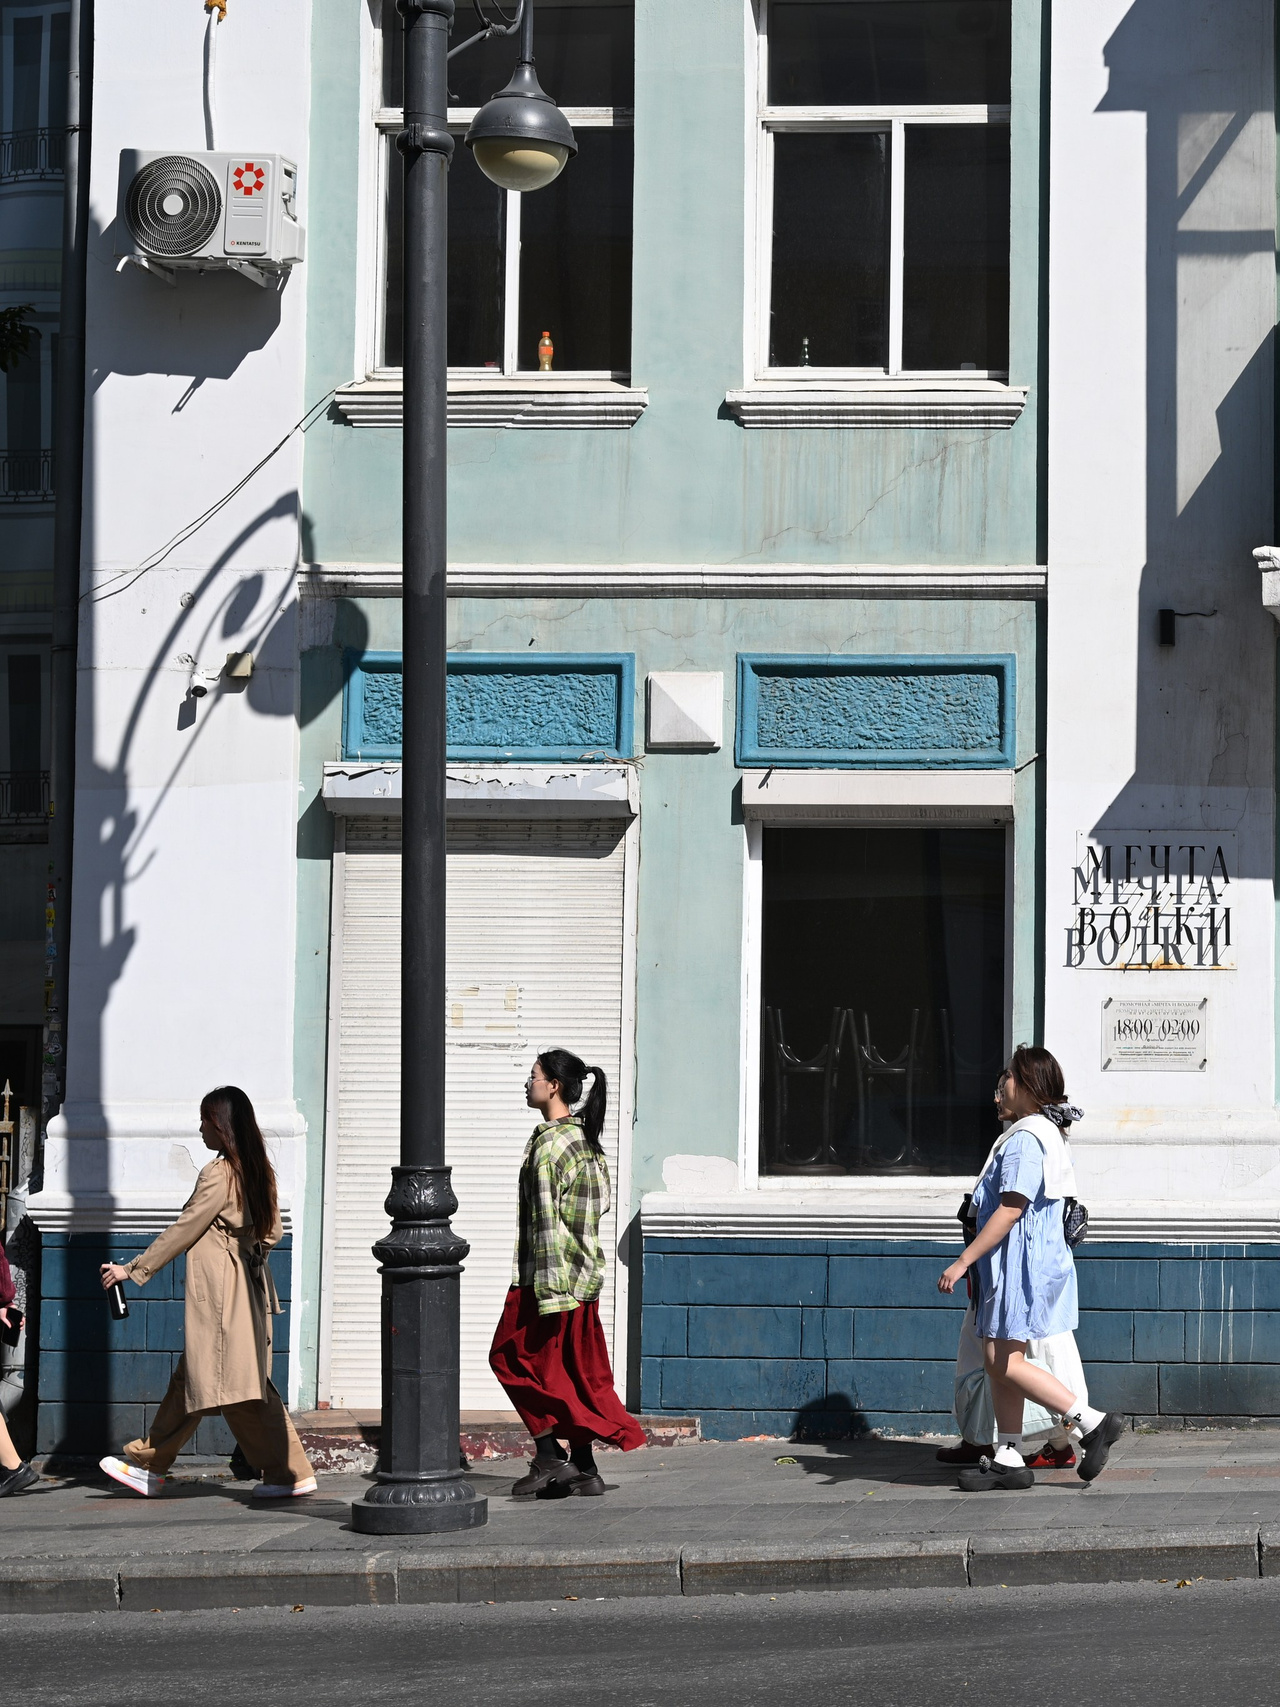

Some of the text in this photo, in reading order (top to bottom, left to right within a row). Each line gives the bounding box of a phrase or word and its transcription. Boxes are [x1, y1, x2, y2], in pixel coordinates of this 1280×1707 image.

[1086, 845, 1231, 884] МЕЧТА
[1079, 905, 1234, 950] ВОДКИ
[1117, 1019, 1153, 1035] 18:00
[1162, 1019, 1200, 1035] 02:00
